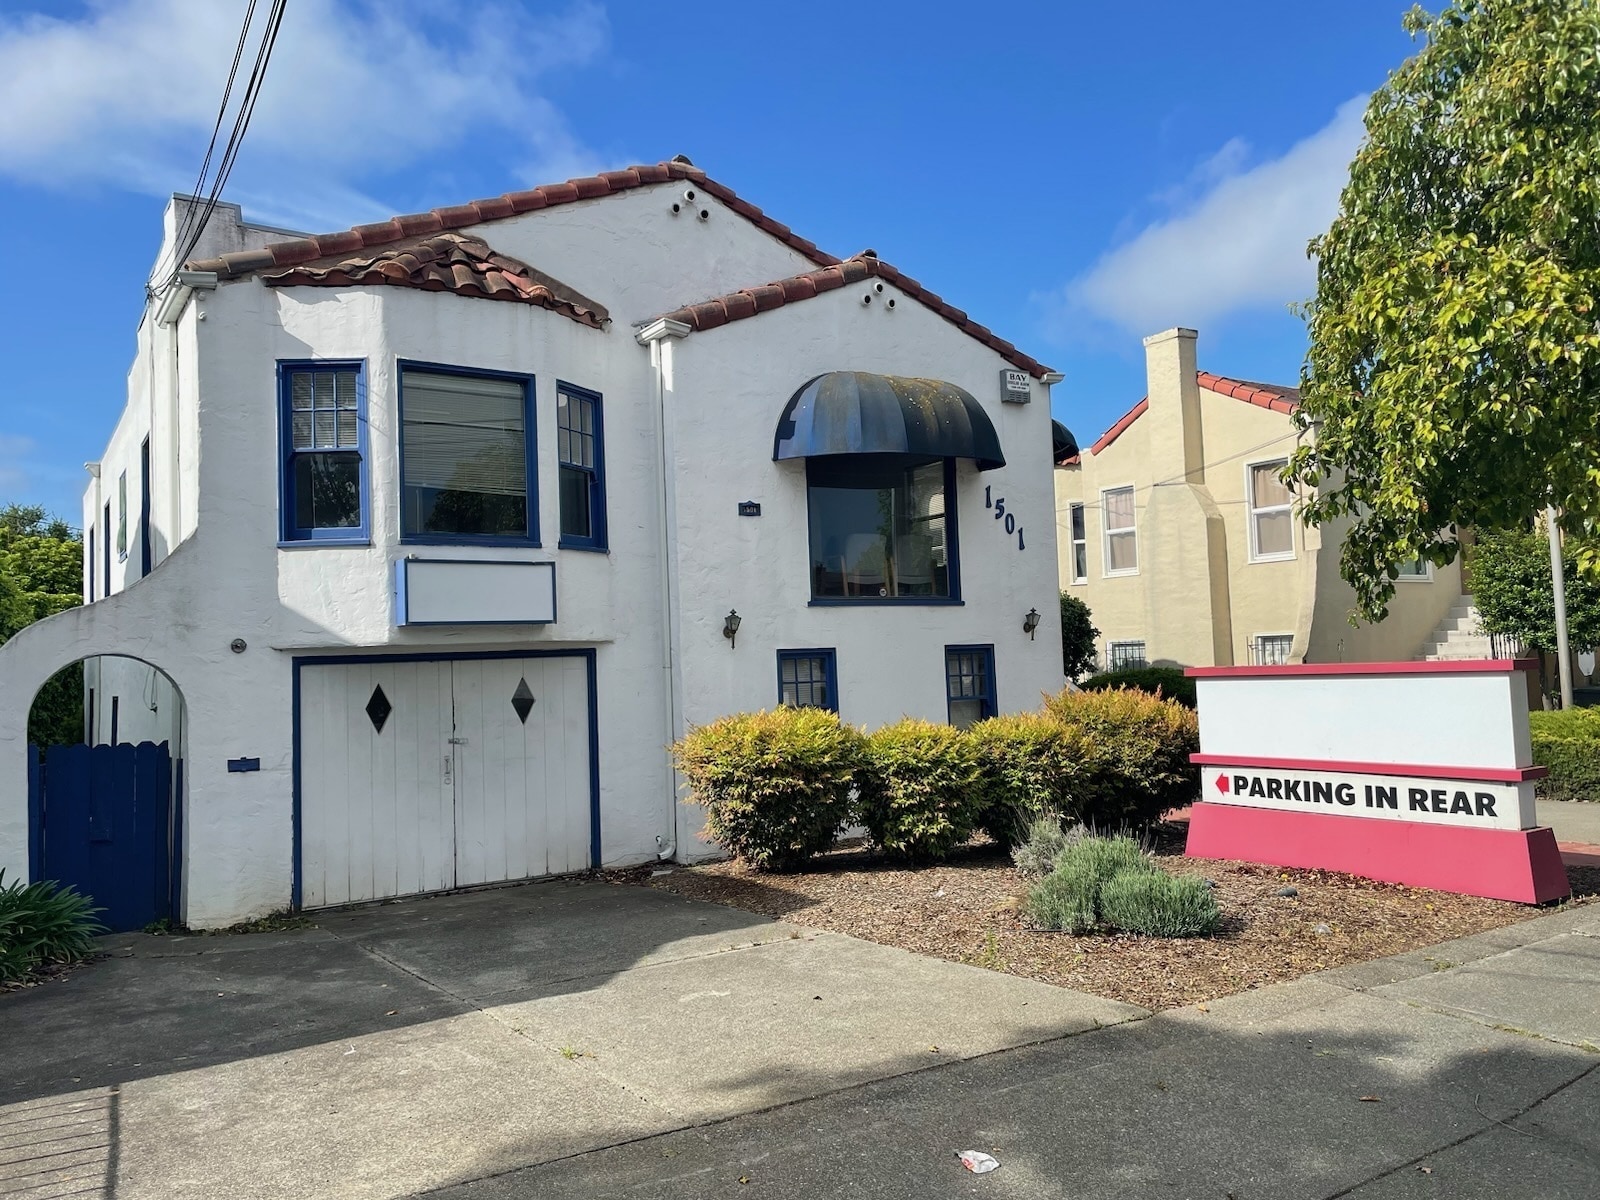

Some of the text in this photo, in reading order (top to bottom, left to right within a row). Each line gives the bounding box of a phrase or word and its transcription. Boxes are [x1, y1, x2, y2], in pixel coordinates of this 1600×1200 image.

[1009, 373, 1027, 382] BAY
[985, 485, 1025, 550] 1501
[1233, 775, 1498, 817] PARKING IN REAR
